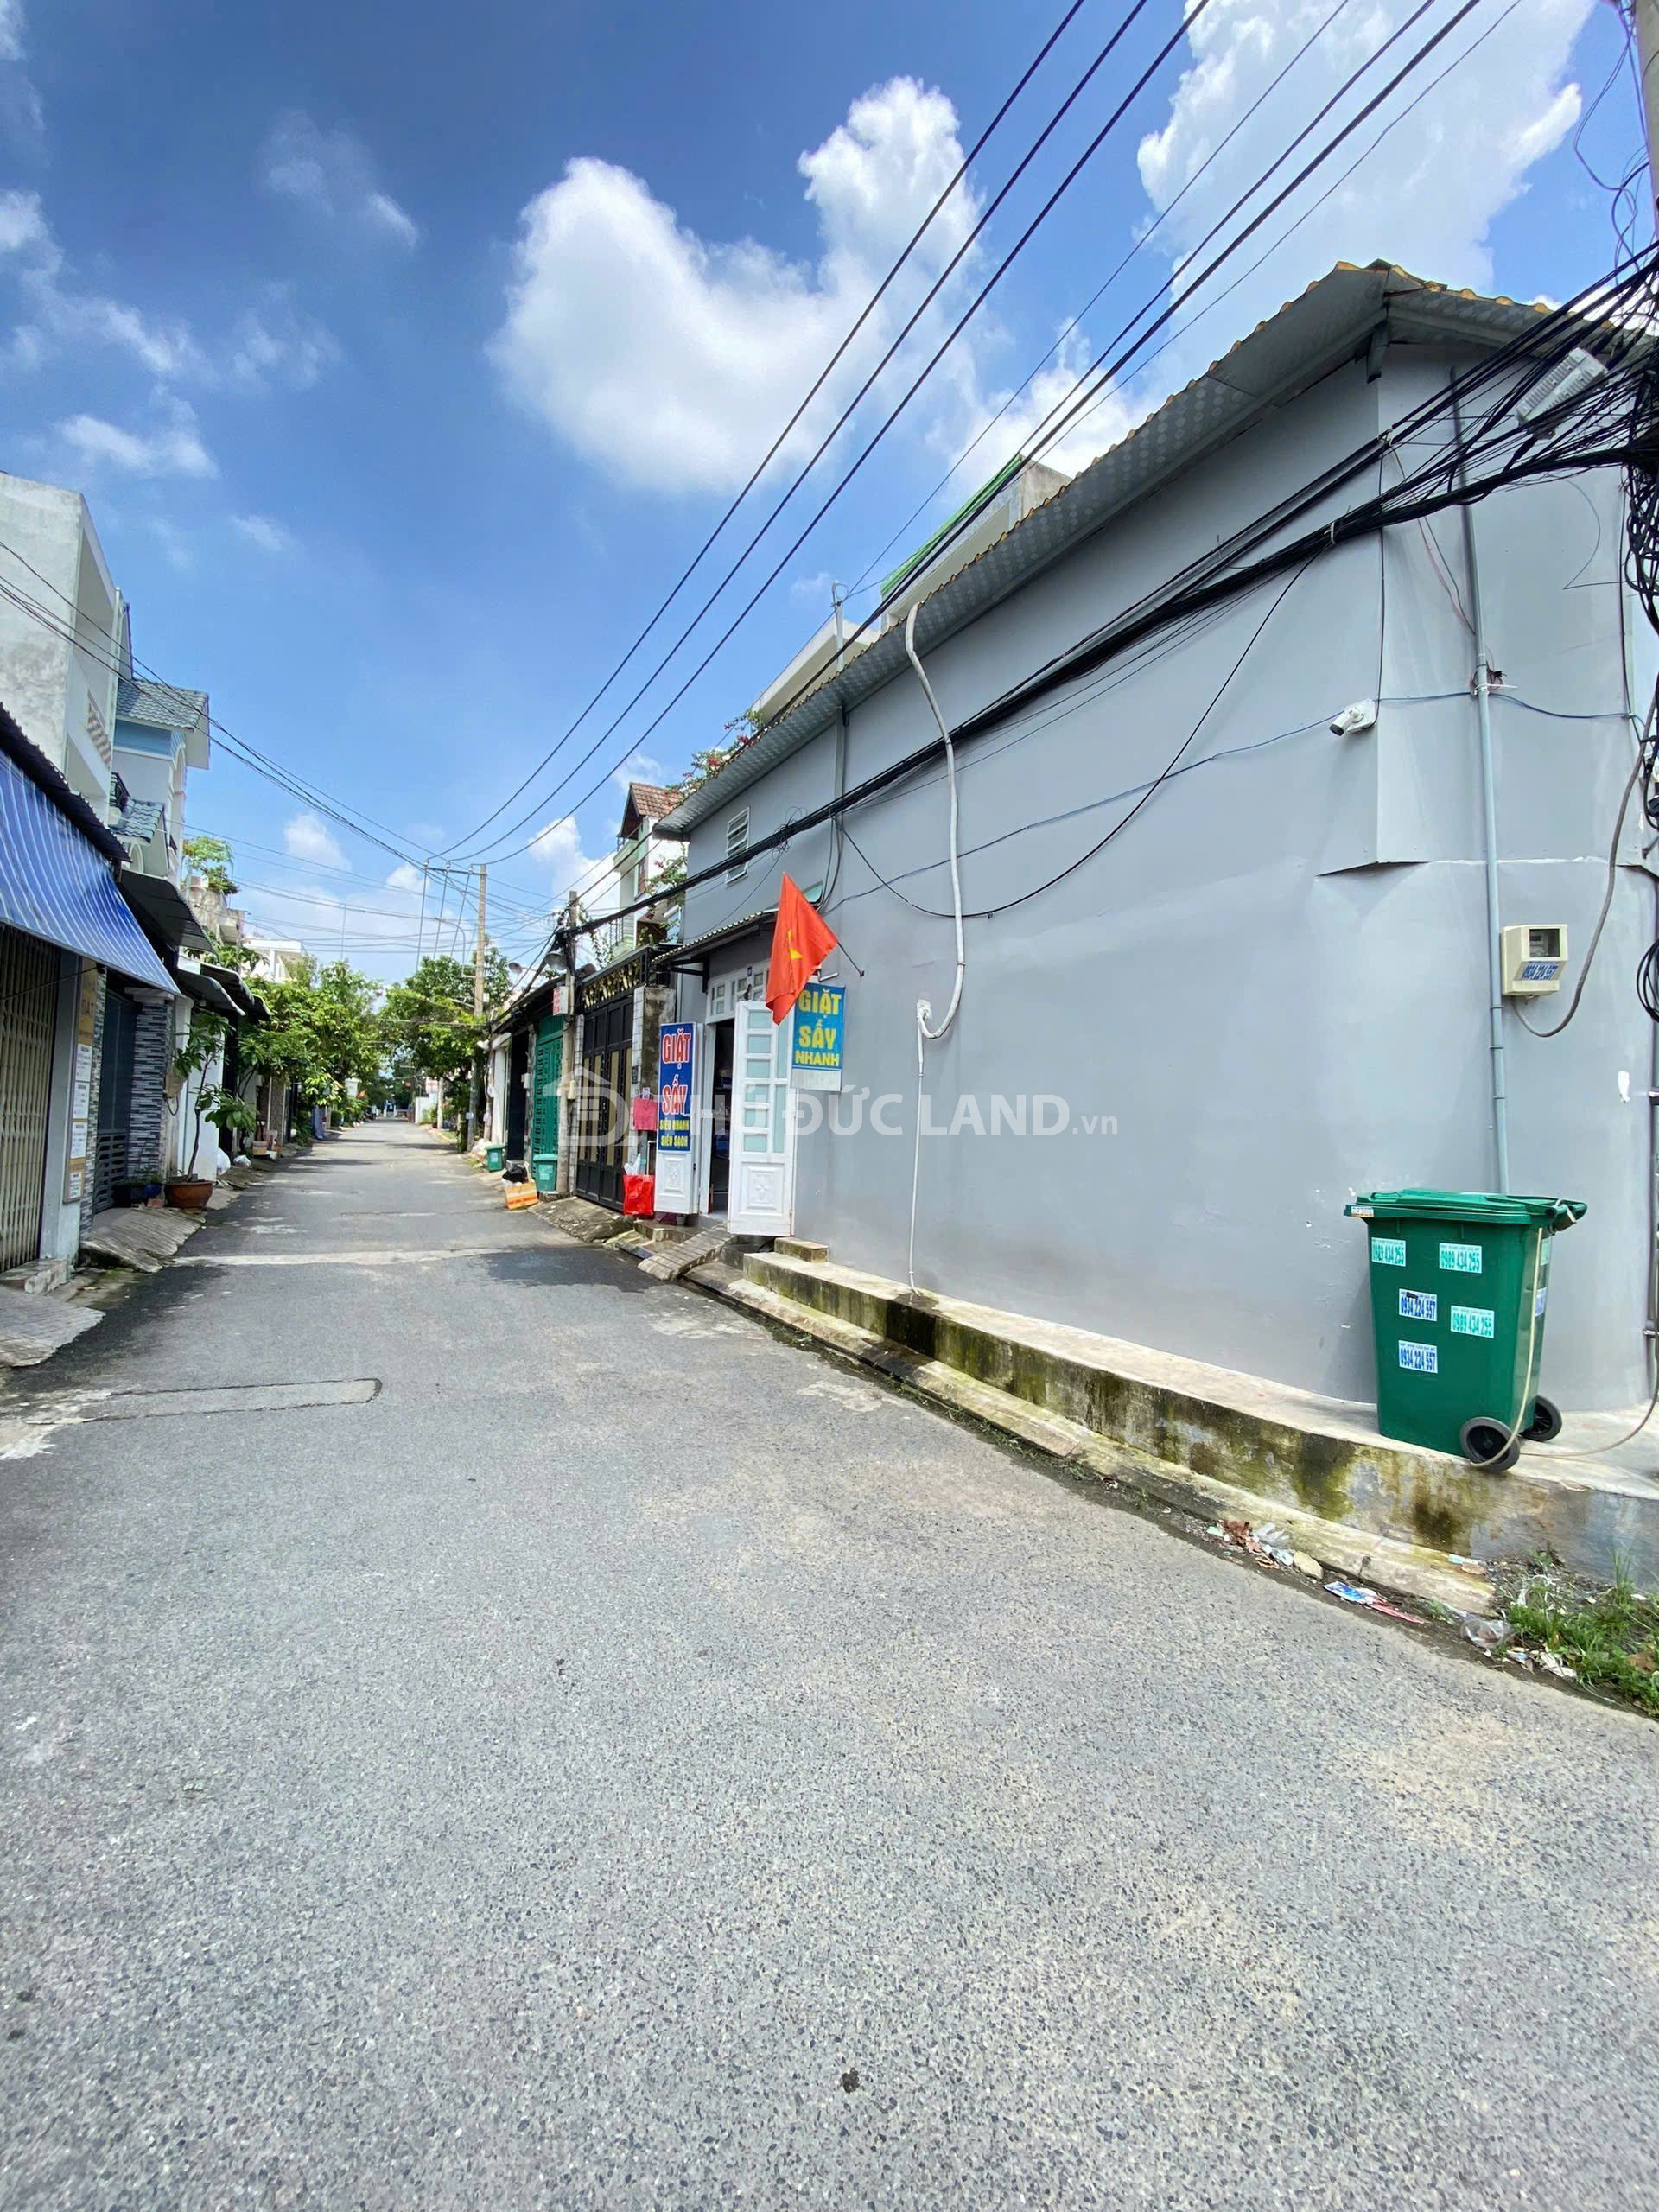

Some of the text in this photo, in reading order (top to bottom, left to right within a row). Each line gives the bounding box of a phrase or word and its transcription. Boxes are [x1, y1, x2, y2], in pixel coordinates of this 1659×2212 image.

[798, 988, 841, 1019] GIẶT
[662, 1027, 691, 1070] GIẶT
[798, 1019, 836, 1050] SẤY
[795, 1050, 840, 1067] NHANH
[662, 1074, 688, 1116] SẤY
